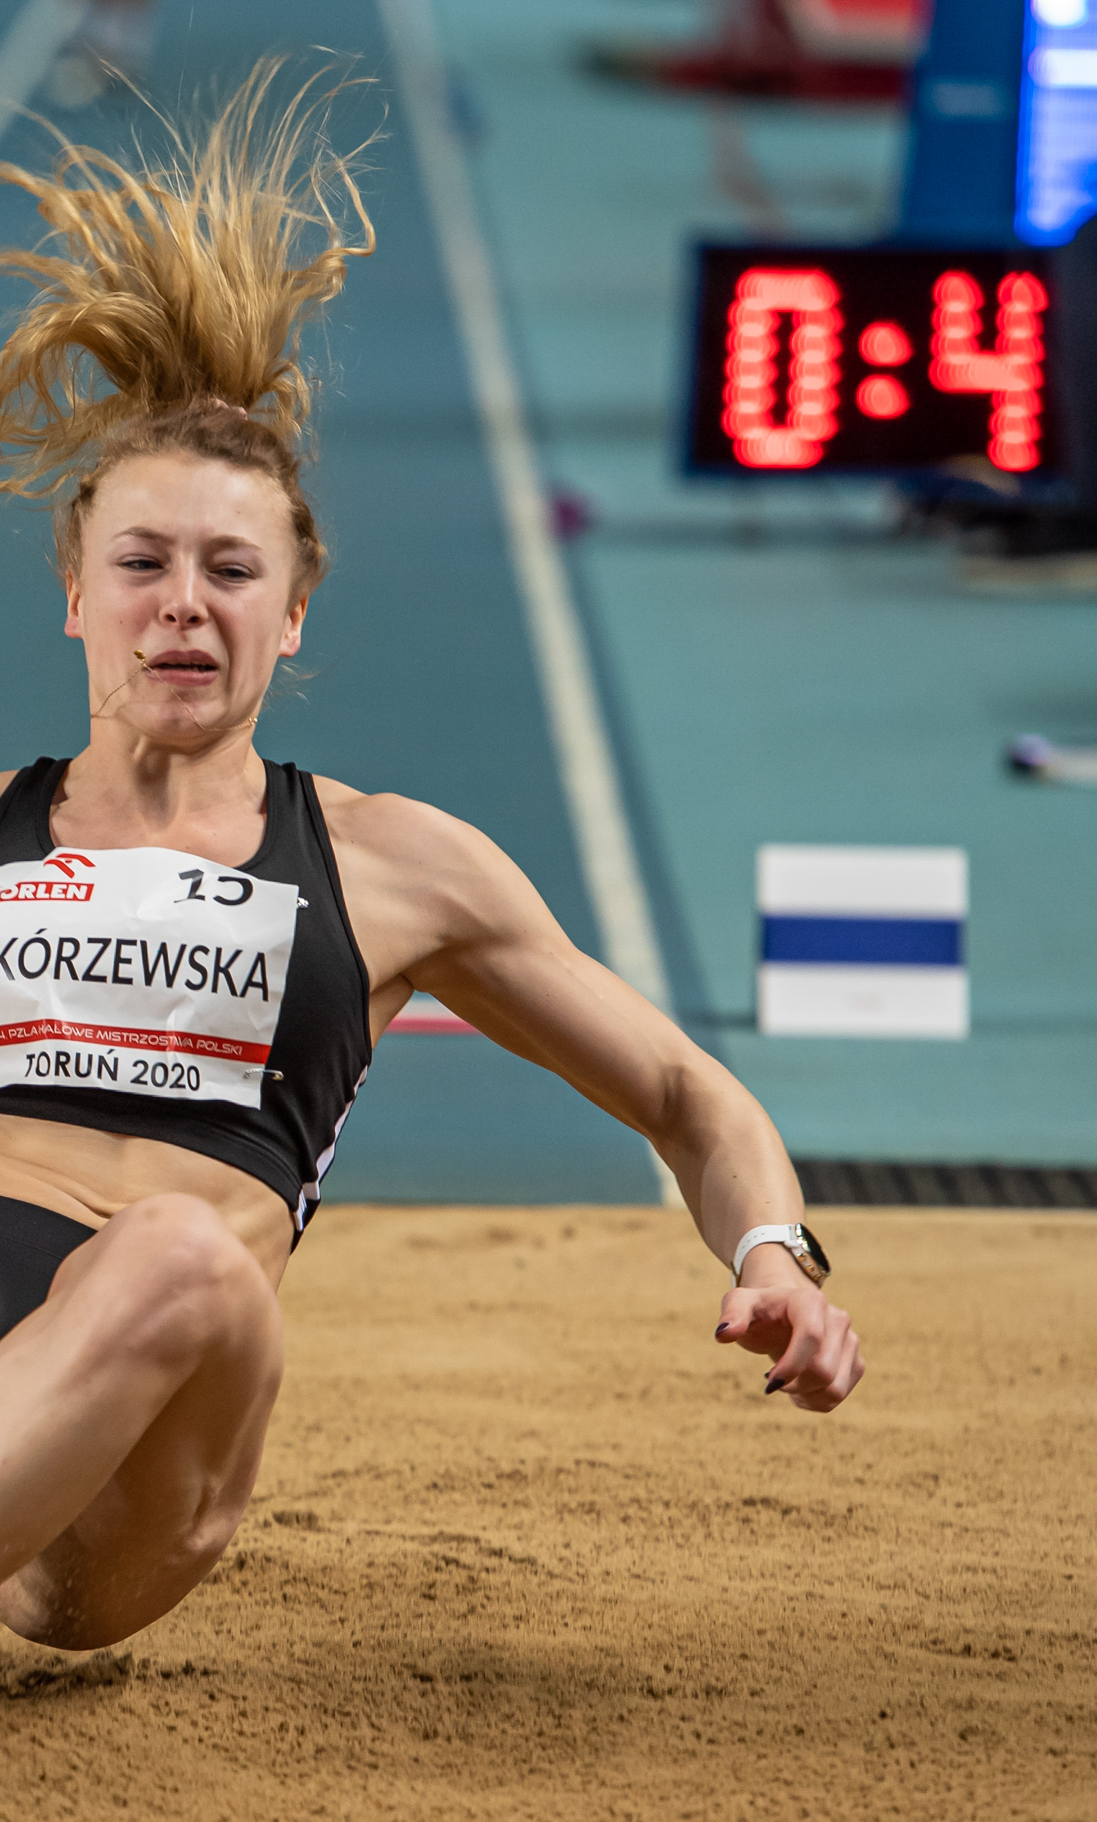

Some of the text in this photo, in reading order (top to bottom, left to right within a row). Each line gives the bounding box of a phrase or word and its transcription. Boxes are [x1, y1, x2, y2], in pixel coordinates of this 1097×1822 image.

[8, 1024, 38, 1039] PZLA
[96, 1029, 194, 1048] MISTRZOSTWA
[196, 1038, 243, 1056] POLSKI
[24, 1048, 200, 1092] TORUŃ 2020
